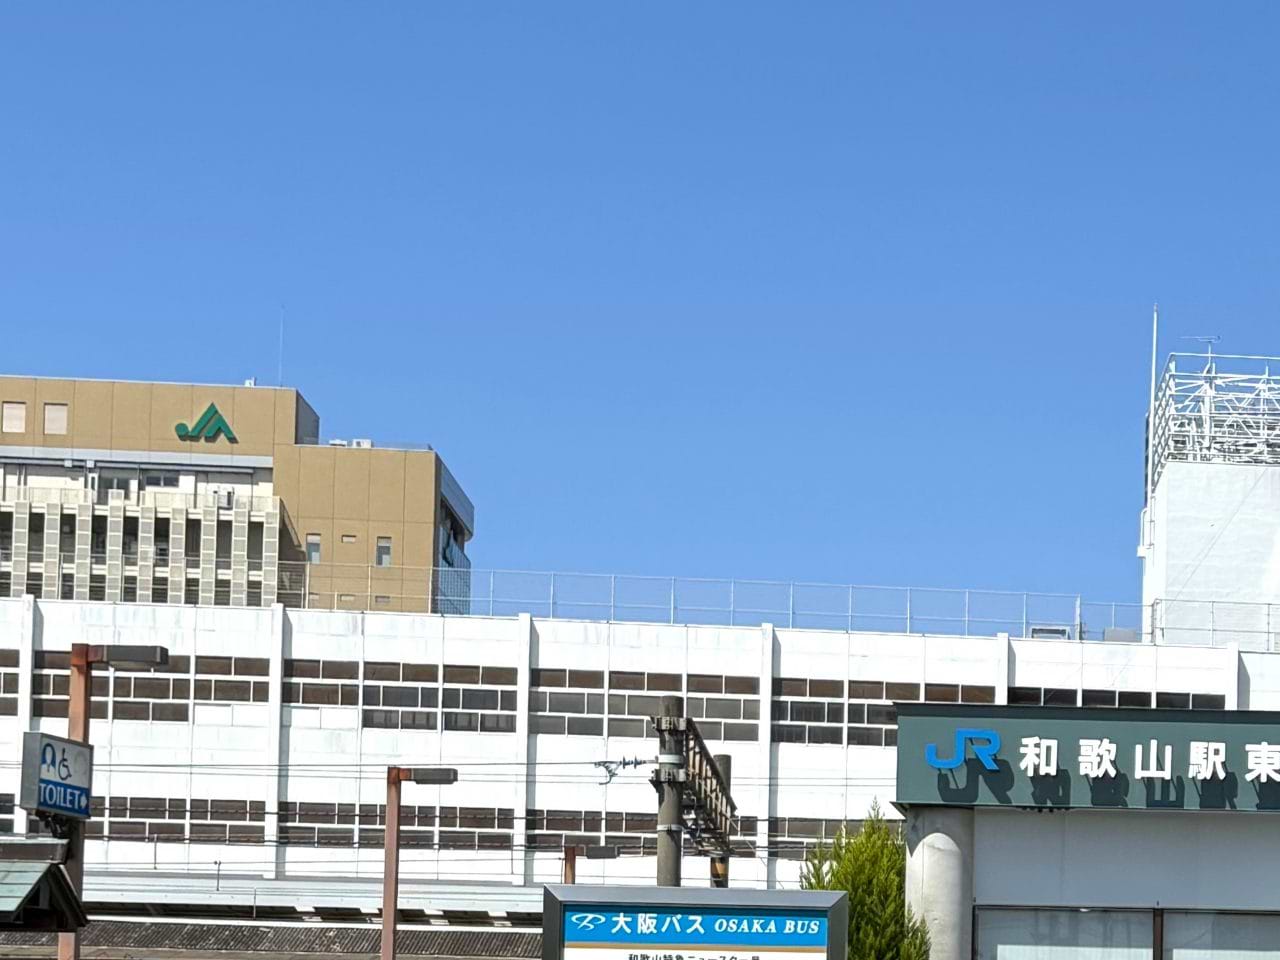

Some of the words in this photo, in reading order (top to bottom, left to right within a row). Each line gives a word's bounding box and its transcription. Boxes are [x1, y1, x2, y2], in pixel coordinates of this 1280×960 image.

[925, 728, 1001, 770] JR
[39, 783, 81, 810] TOILET
[611, 914, 705, 934] 大阪バス
[714, 919, 777, 934] OSAKA
[783, 920, 819, 935] BUS
